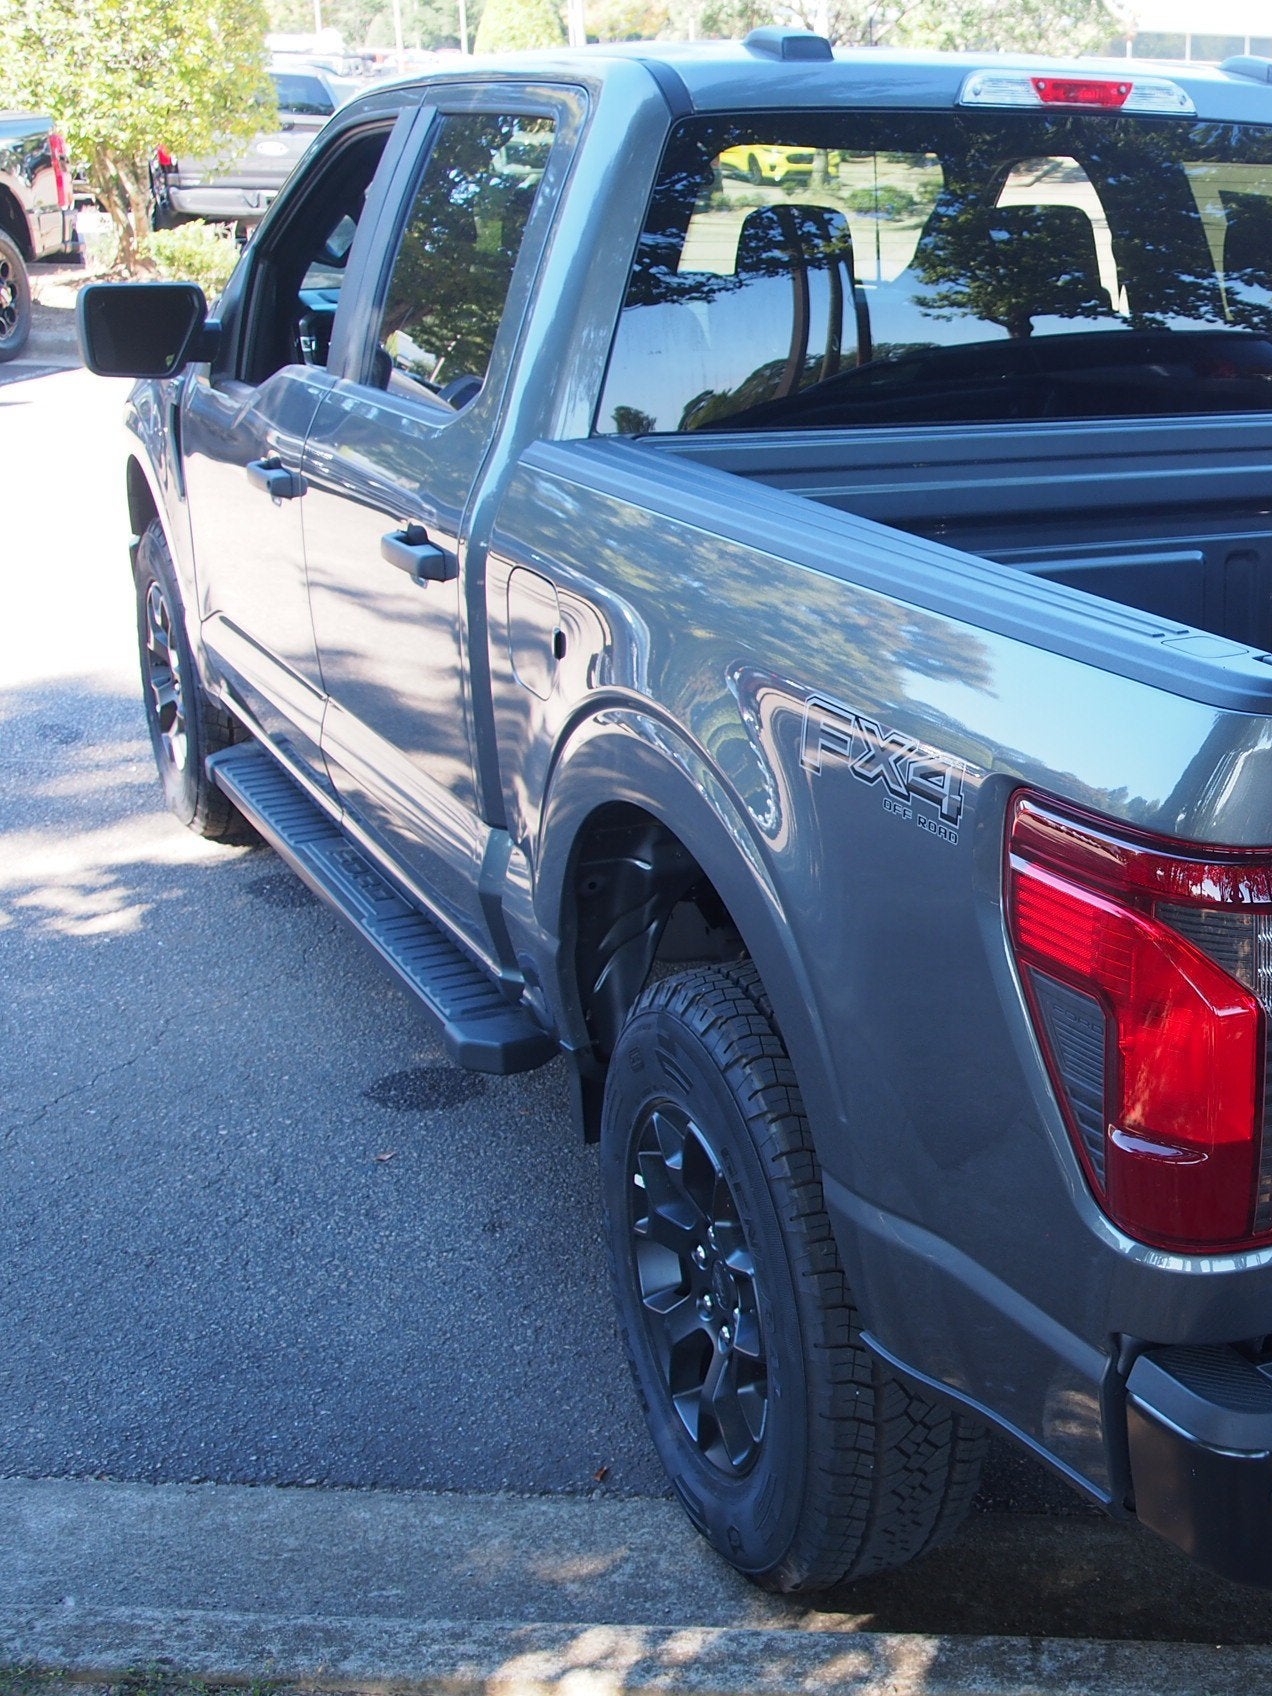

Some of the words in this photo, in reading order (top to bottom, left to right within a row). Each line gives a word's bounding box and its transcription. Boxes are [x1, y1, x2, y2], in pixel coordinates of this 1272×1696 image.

[800, 694, 967, 829] FX4
[882, 797, 913, 820] OFF
[916, 813, 959, 845] ROAD
[720, 1147, 781, 1402] GENRAL
